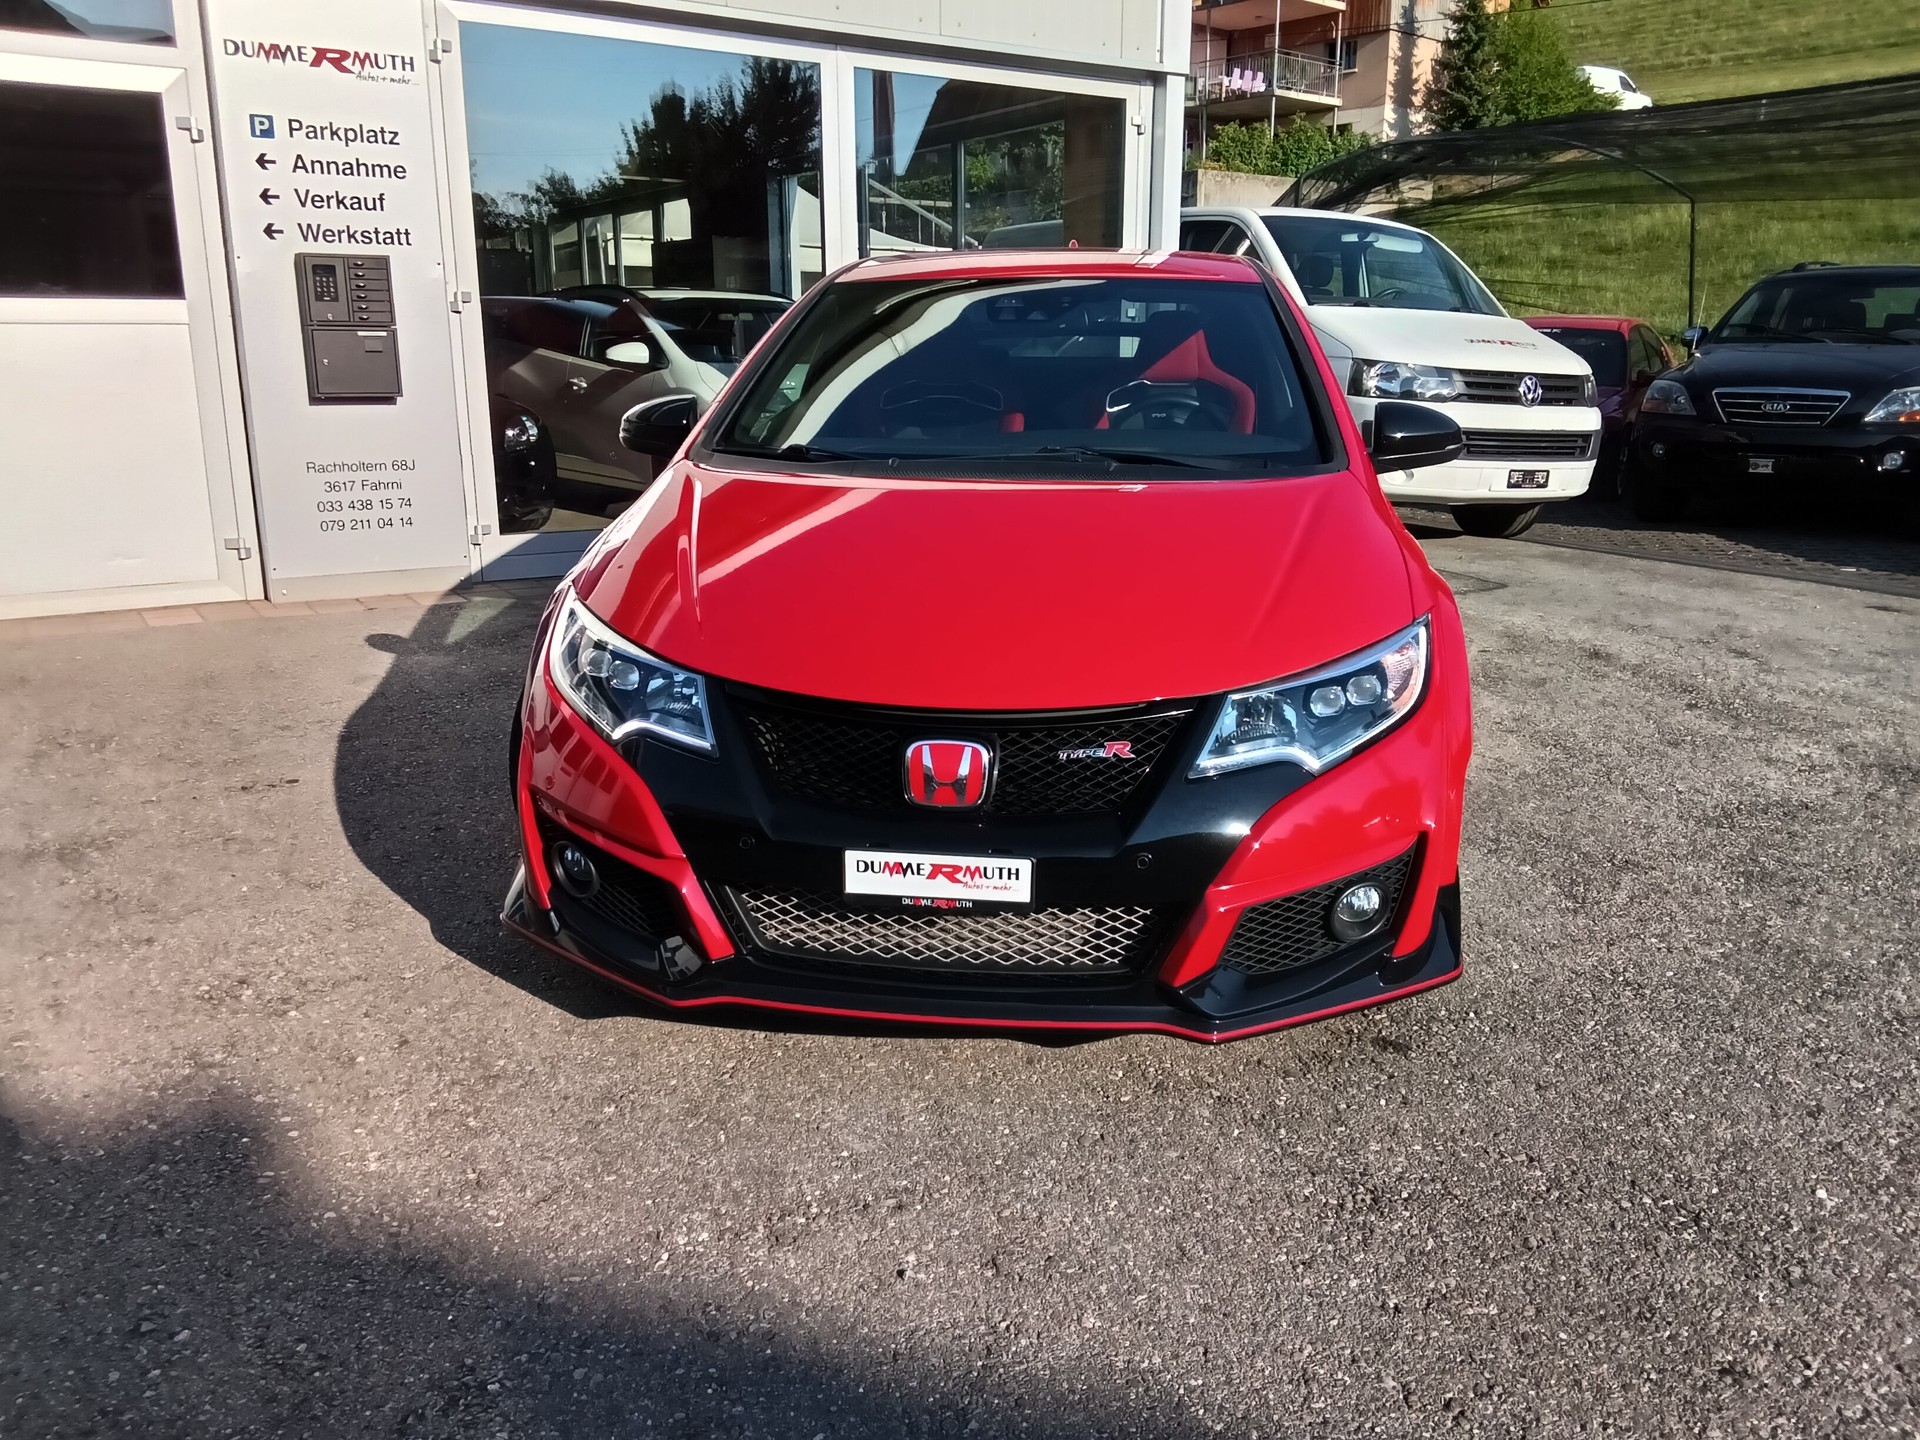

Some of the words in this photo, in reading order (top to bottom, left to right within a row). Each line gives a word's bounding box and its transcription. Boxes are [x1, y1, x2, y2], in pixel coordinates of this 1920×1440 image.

[223, 38, 415, 74] DUMMERMUTH
[288, 118, 401, 147] Parkplatz
[292, 154, 407, 180] Annahme
[294, 188, 386, 212] Verkauf
[297, 223, 412, 246] Werkstatt
[1766, 403, 1785, 411] KIA
[306, 461, 387, 474] Rachholtern
[391, 459, 416, 471] 68J
[324, 480, 356, 493] 3617
[361, 478, 402, 491] Fahrni
[317, 500, 343, 513] 033
[348, 499, 373, 511] 438
[379, 498, 393, 509] 15
[398, 497, 412, 509] 74
[320, 519, 345, 532] 079
[350, 518, 371, 530] 211
[377, 517, 393, 529] 04
[399, 516, 413, 528] 14
[856, 859, 1020, 884] DUMMERMUTH
[901, 897, 973, 909] DUMMERMUTH
